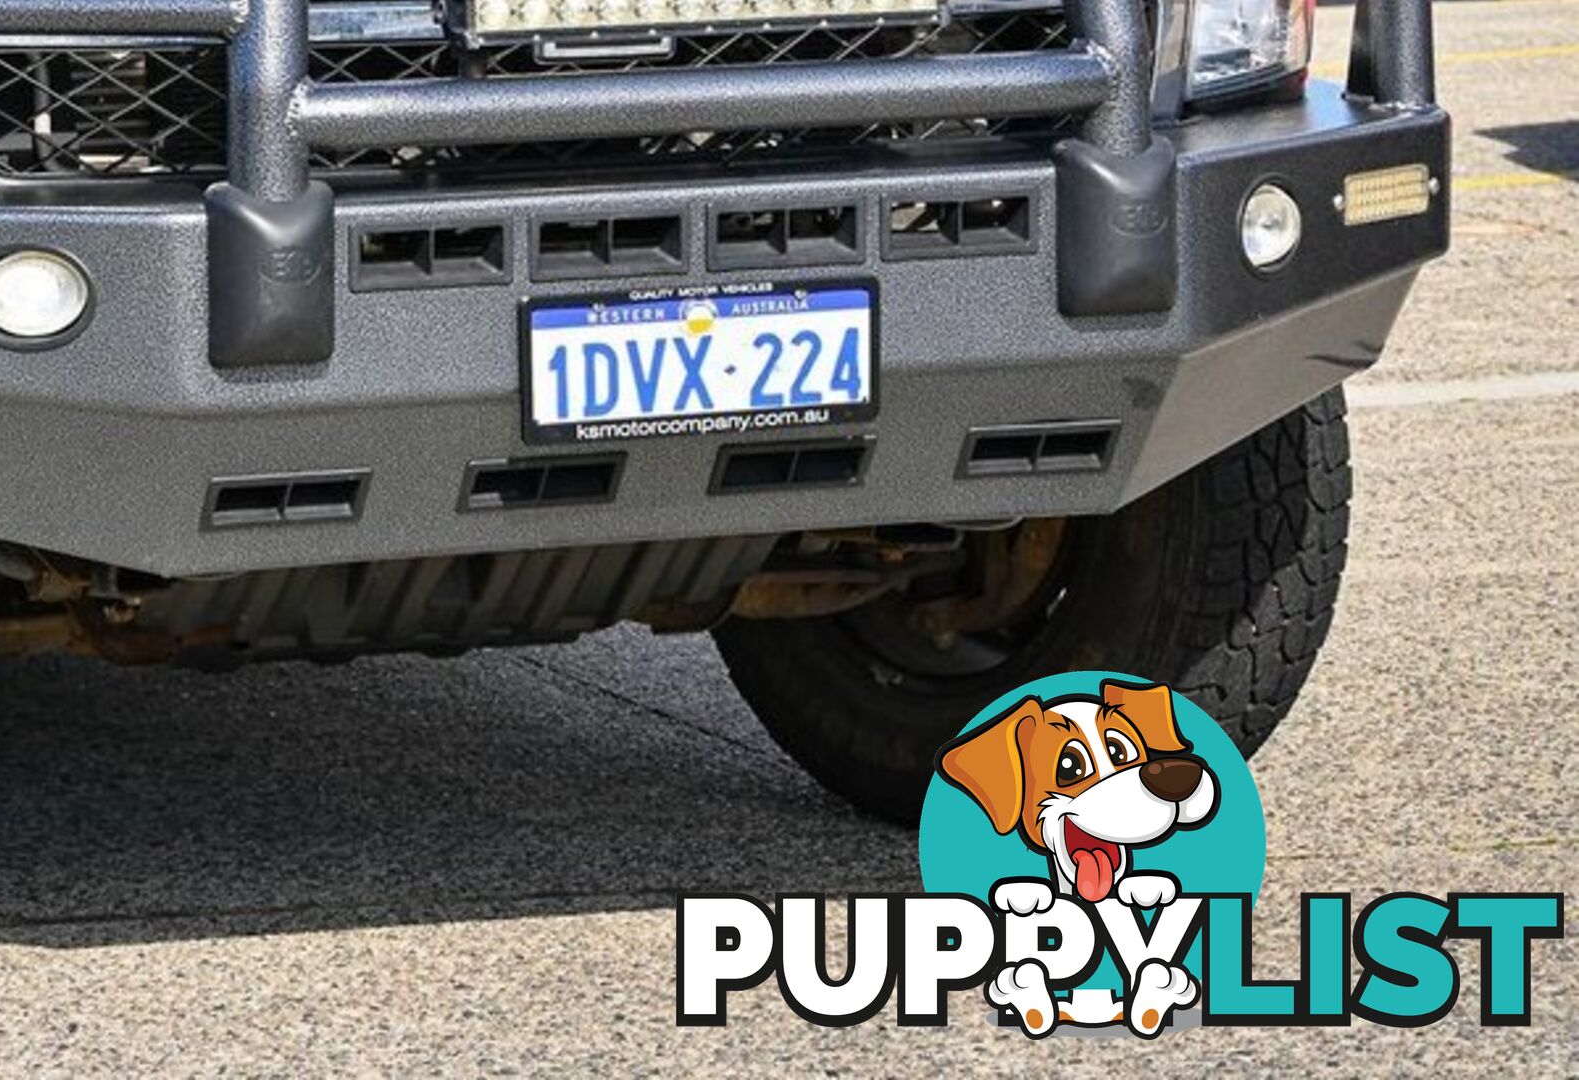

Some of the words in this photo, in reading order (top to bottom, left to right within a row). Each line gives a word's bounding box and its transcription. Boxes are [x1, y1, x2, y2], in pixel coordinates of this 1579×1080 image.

[628, 290, 673, 301] QUALITY
[678, 286, 718, 297] MOTOR
[722, 282, 773, 294] VEHICLES
[586, 307, 665, 324] WESTERN
[731, 297, 810, 315] AUSTRALIA
[575, 408, 830, 441] ksmotorcompany.com.au
